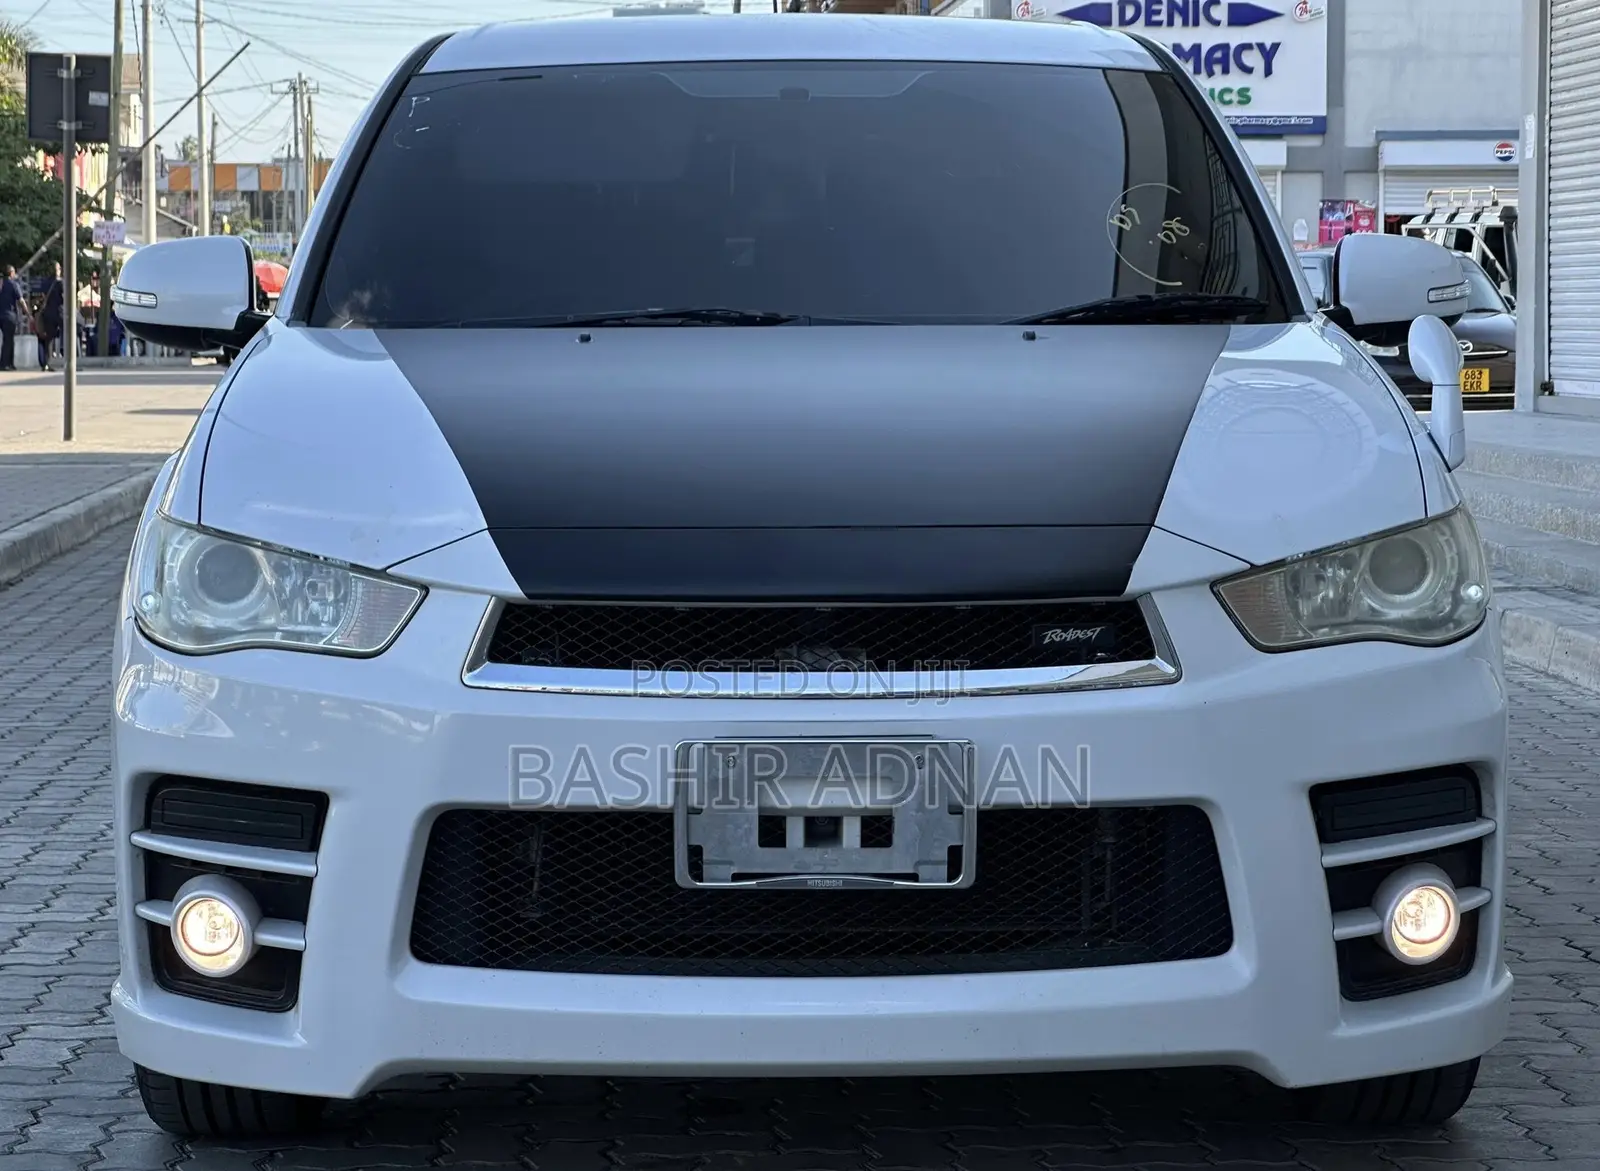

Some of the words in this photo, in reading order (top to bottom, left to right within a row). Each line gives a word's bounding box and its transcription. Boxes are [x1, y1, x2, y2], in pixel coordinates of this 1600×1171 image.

[1118, 0, 1222, 27] DENIC
[1464, 370, 1483, 380] 683
[1463, 381, 1482, 391] EKR
[1040, 626, 1107, 644] ROADEST
[806, 879, 843, 887] MITSUBISHI
